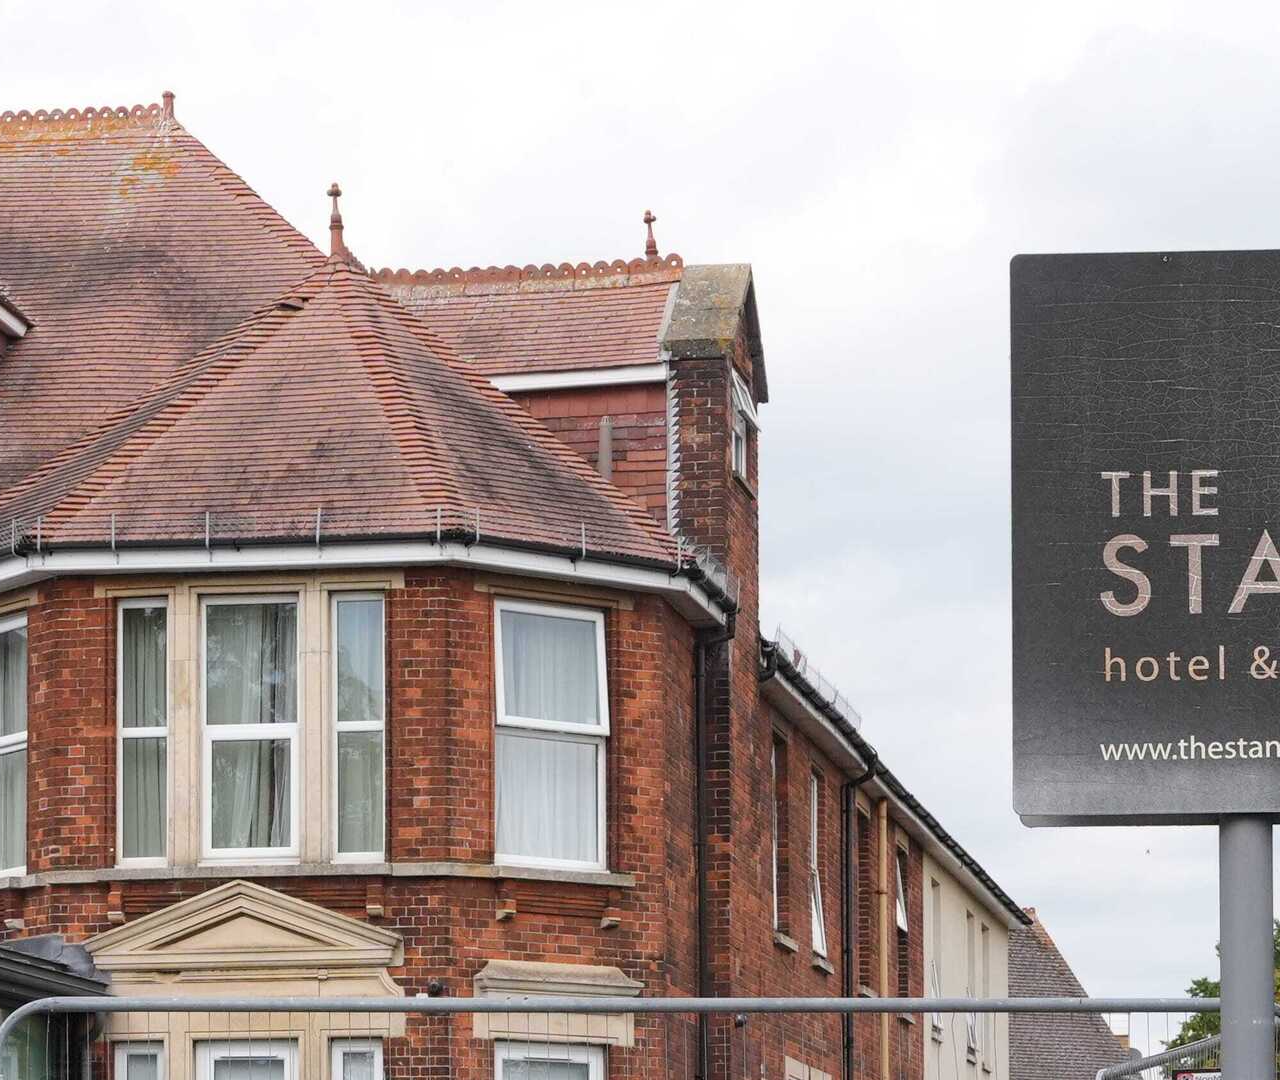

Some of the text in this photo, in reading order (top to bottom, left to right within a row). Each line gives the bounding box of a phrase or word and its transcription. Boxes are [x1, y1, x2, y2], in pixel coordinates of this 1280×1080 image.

[1100, 469, 1220, 518] THE
[1103, 644, 1226, 683] hotel
[1249, 644, 1278, 681] &
